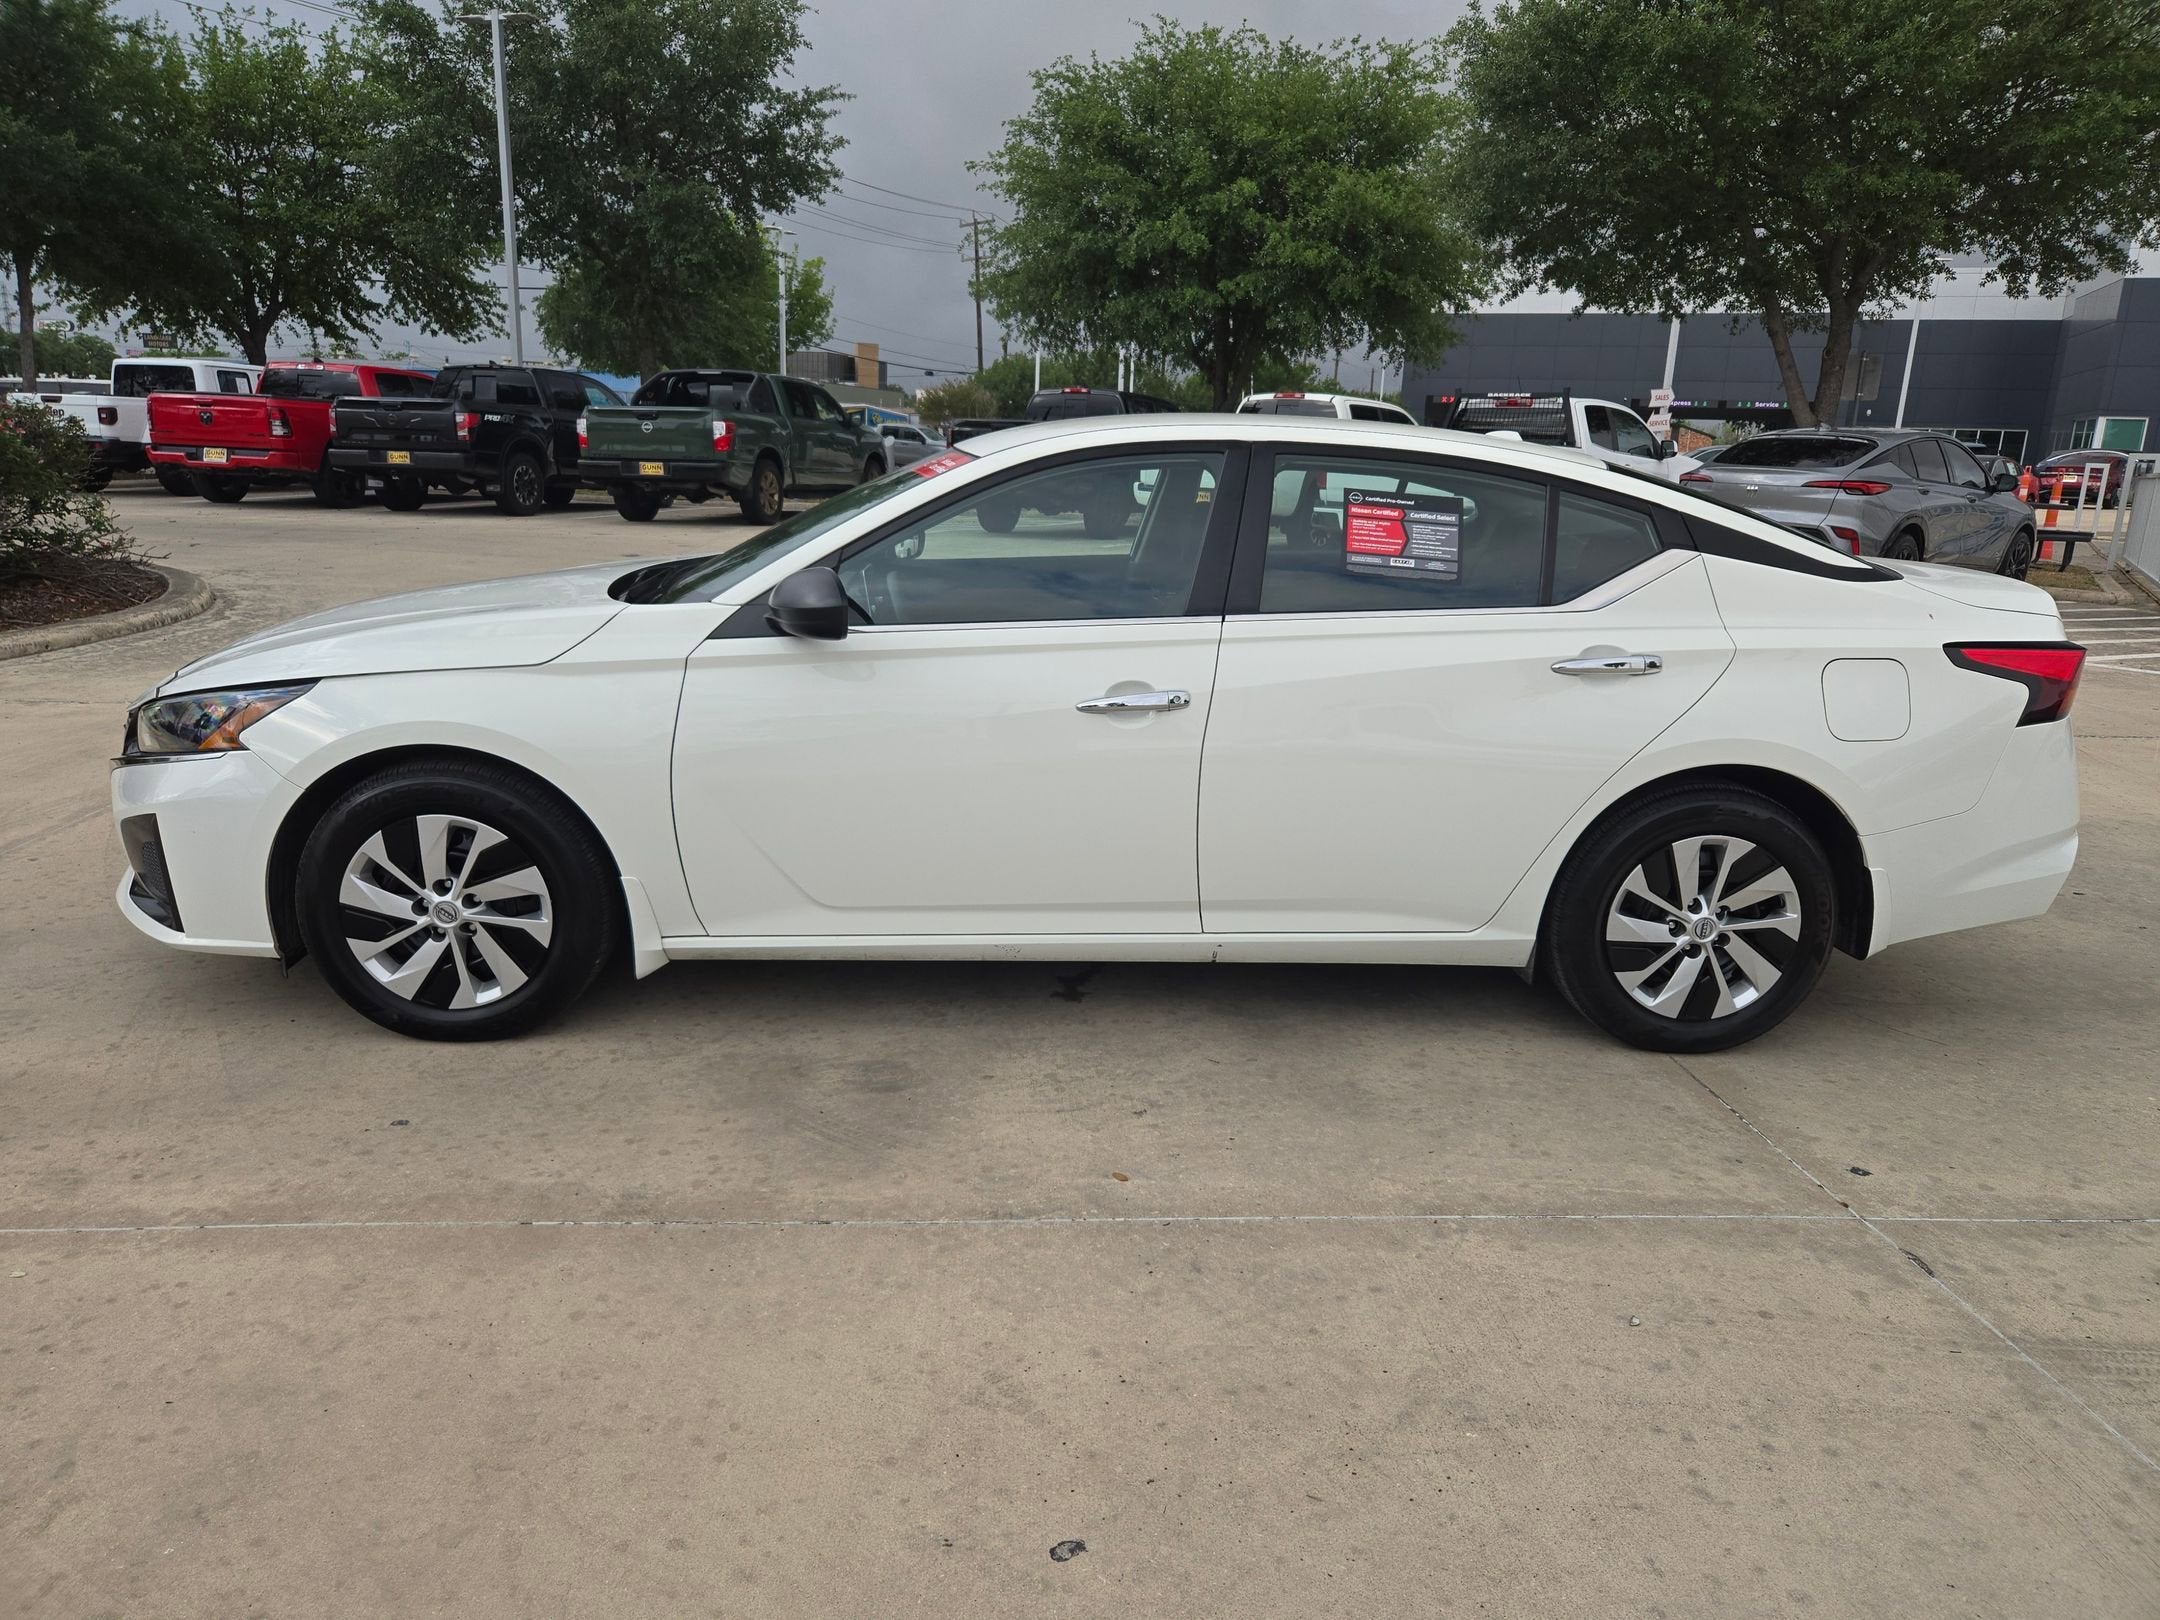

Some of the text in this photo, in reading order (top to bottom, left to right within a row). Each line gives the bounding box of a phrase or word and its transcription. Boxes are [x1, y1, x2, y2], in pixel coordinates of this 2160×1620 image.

[641, 463, 662, 471] GUNN
[1387, 497, 1415, 505] Pre-Owned
[1351, 507, 1399, 517] Nissan Certified
[1410, 512, 1456, 522] Certified Select
